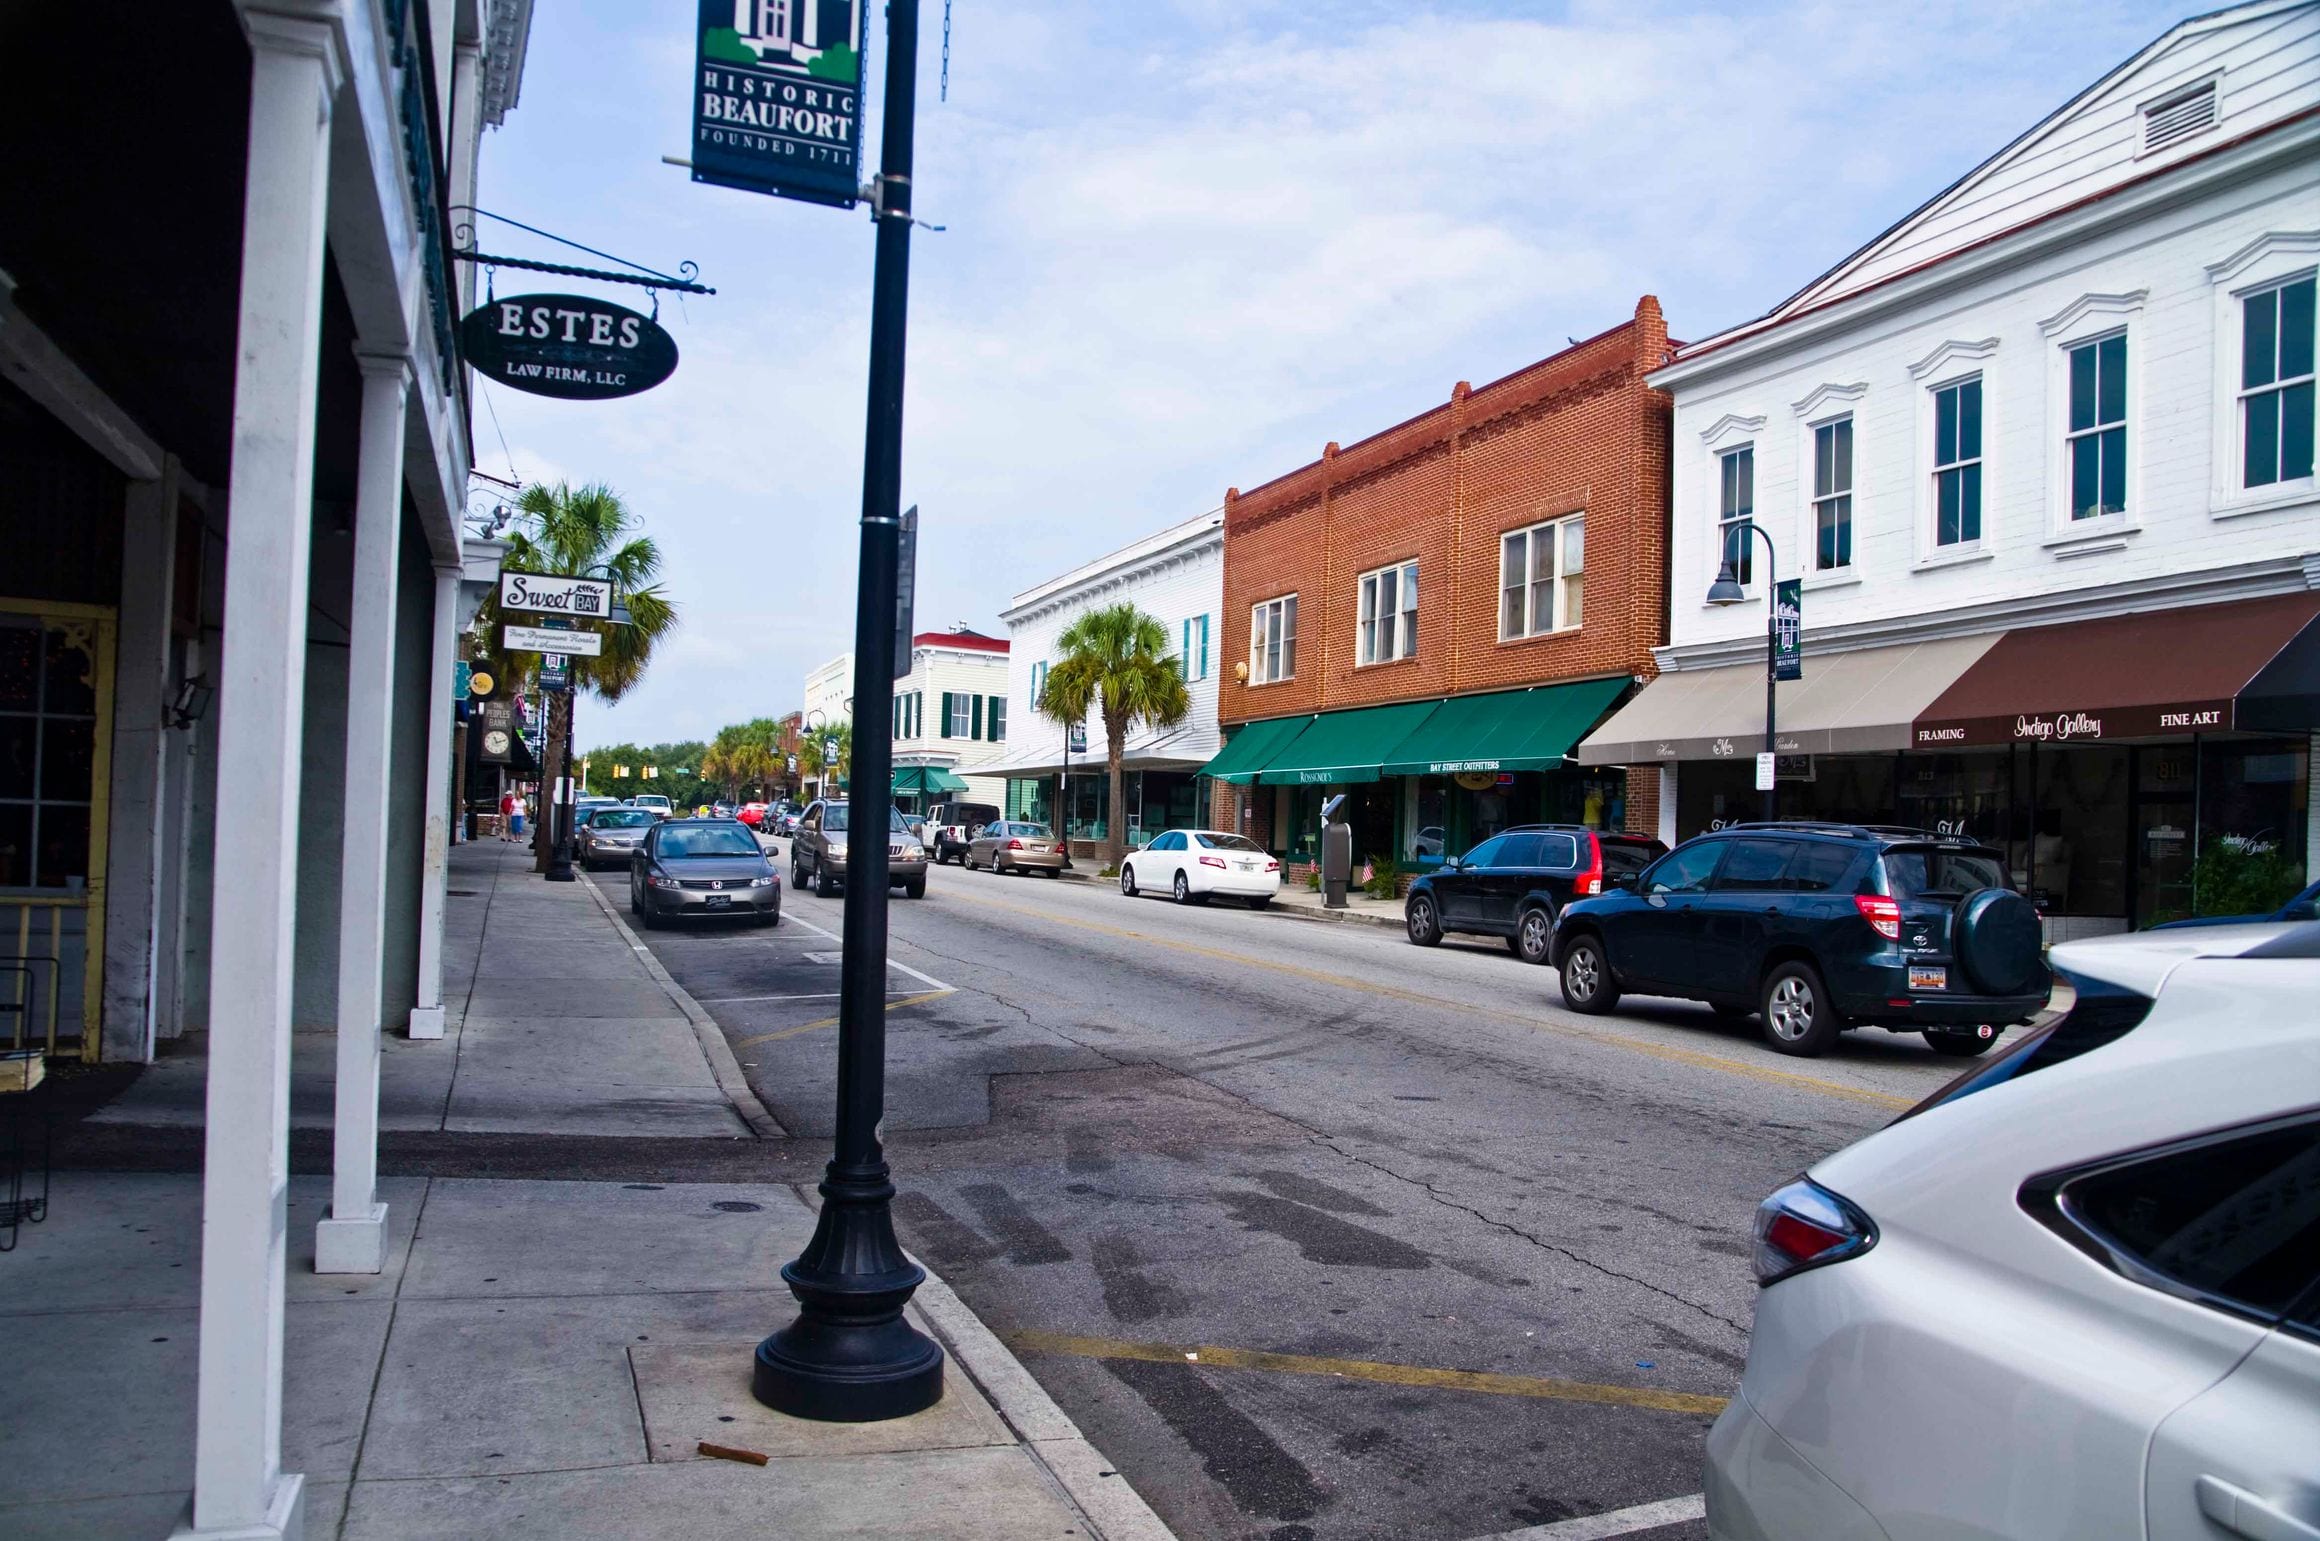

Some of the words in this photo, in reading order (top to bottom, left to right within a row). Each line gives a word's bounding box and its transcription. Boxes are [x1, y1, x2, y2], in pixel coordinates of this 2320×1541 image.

[704, 71, 854, 113] HISTORIC
[702, 93, 853, 142] BEAUFORT
[700, 128, 795, 156] FOUNDED
[809, 146, 851, 166] 1711
[498, 303, 640, 349] ESTES
[506, 362, 542, 378] LAW
[545, 366, 591, 385] FIRM,
[595, 371, 626, 386] LLC
[507, 577, 575, 610] Sweet
[576, 595, 599, 612] BAY
[1776, 658, 1799, 667] BEAUFORT
[486, 709, 511, 719] PEOPLES
[493, 702, 504, 710] THE
[489, 718, 507, 727] BANK
[1919, 728, 1965, 741] FRAMING
[2014, 715, 2054, 741] Indigo
[2056, 713, 2101, 739] Gallery
[2160, 713, 2189, 727] FINE
[2191, 711, 2221, 725] ART
[1430, 763, 1441, 772] BAY
[1442, 762, 1463, 771] STREET
[1463, 760, 1500, 770] OUTFITTERS
